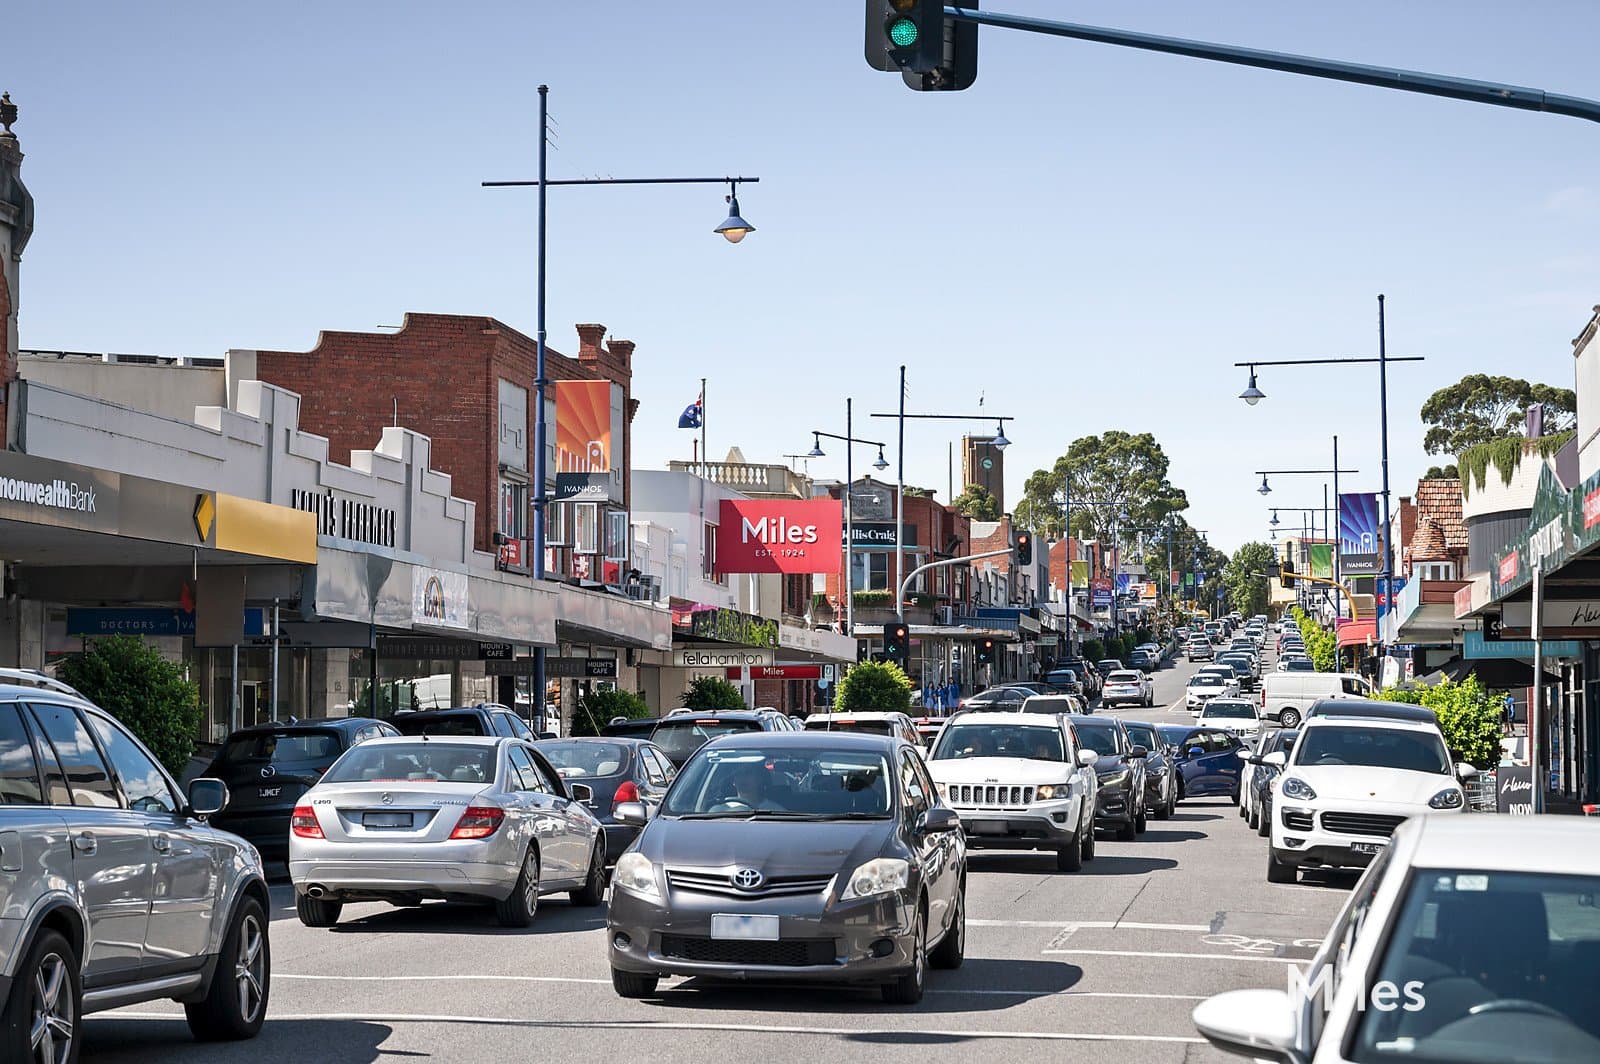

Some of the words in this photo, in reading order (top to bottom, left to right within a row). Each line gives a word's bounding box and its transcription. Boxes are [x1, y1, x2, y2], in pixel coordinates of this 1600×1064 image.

[564, 485, 603, 493] IVANHOE
[341, 499, 398, 548] PHARMACY
[742, 516, 819, 544] Miles
[781, 549, 806, 557] 1924
[100, 620, 155, 630] DOCTORS
[763, 667, 785, 676] Miles
